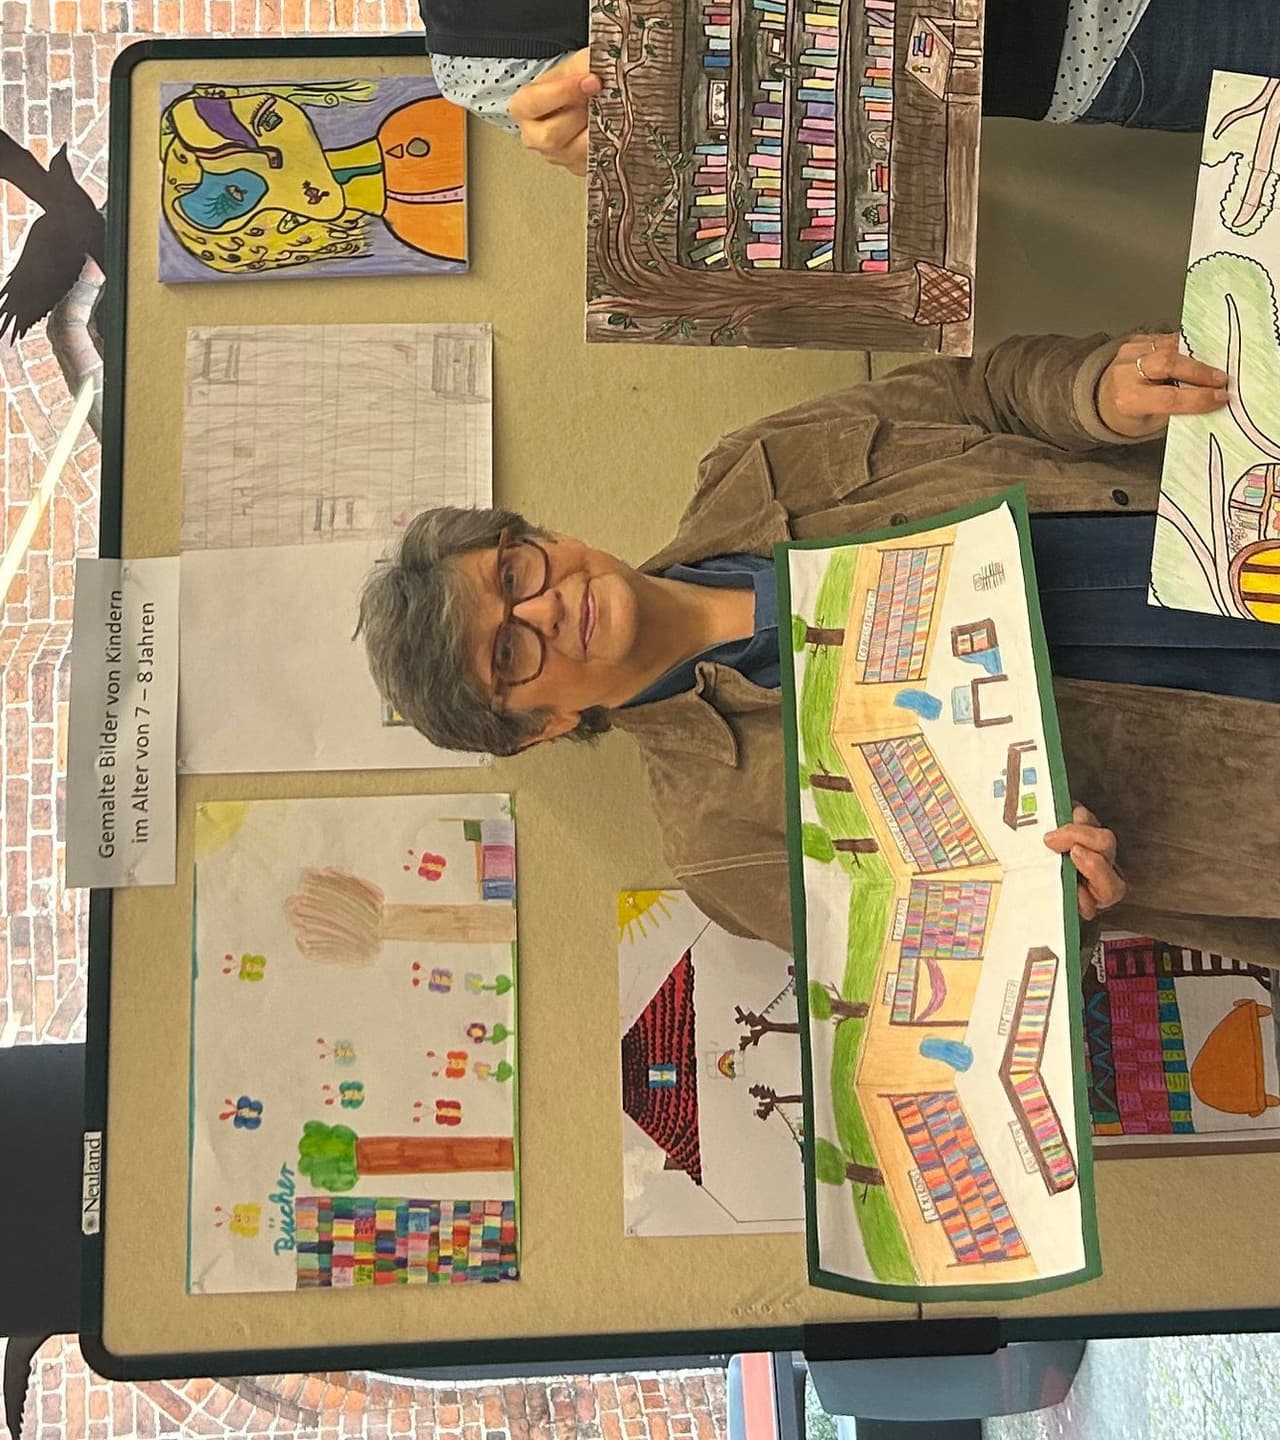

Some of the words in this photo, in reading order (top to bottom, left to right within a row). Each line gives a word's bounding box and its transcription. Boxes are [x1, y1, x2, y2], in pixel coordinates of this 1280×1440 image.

[104, 589, 123, 664] Kindern
[137, 601, 155, 666] Jahren
[105, 670, 121, 706] von
[136, 671, 154, 684] 8
[135, 706, 151, 719] 7
[98, 711, 119, 769] Bilder
[135, 723, 151, 760] von
[131, 765, 150, 813] Alter
[97, 774, 117, 859] Gemalte
[131, 818, 150, 844] im
[83, 1137, 101, 1214] Neuland
[268, 1161, 297, 1256] Bücher
